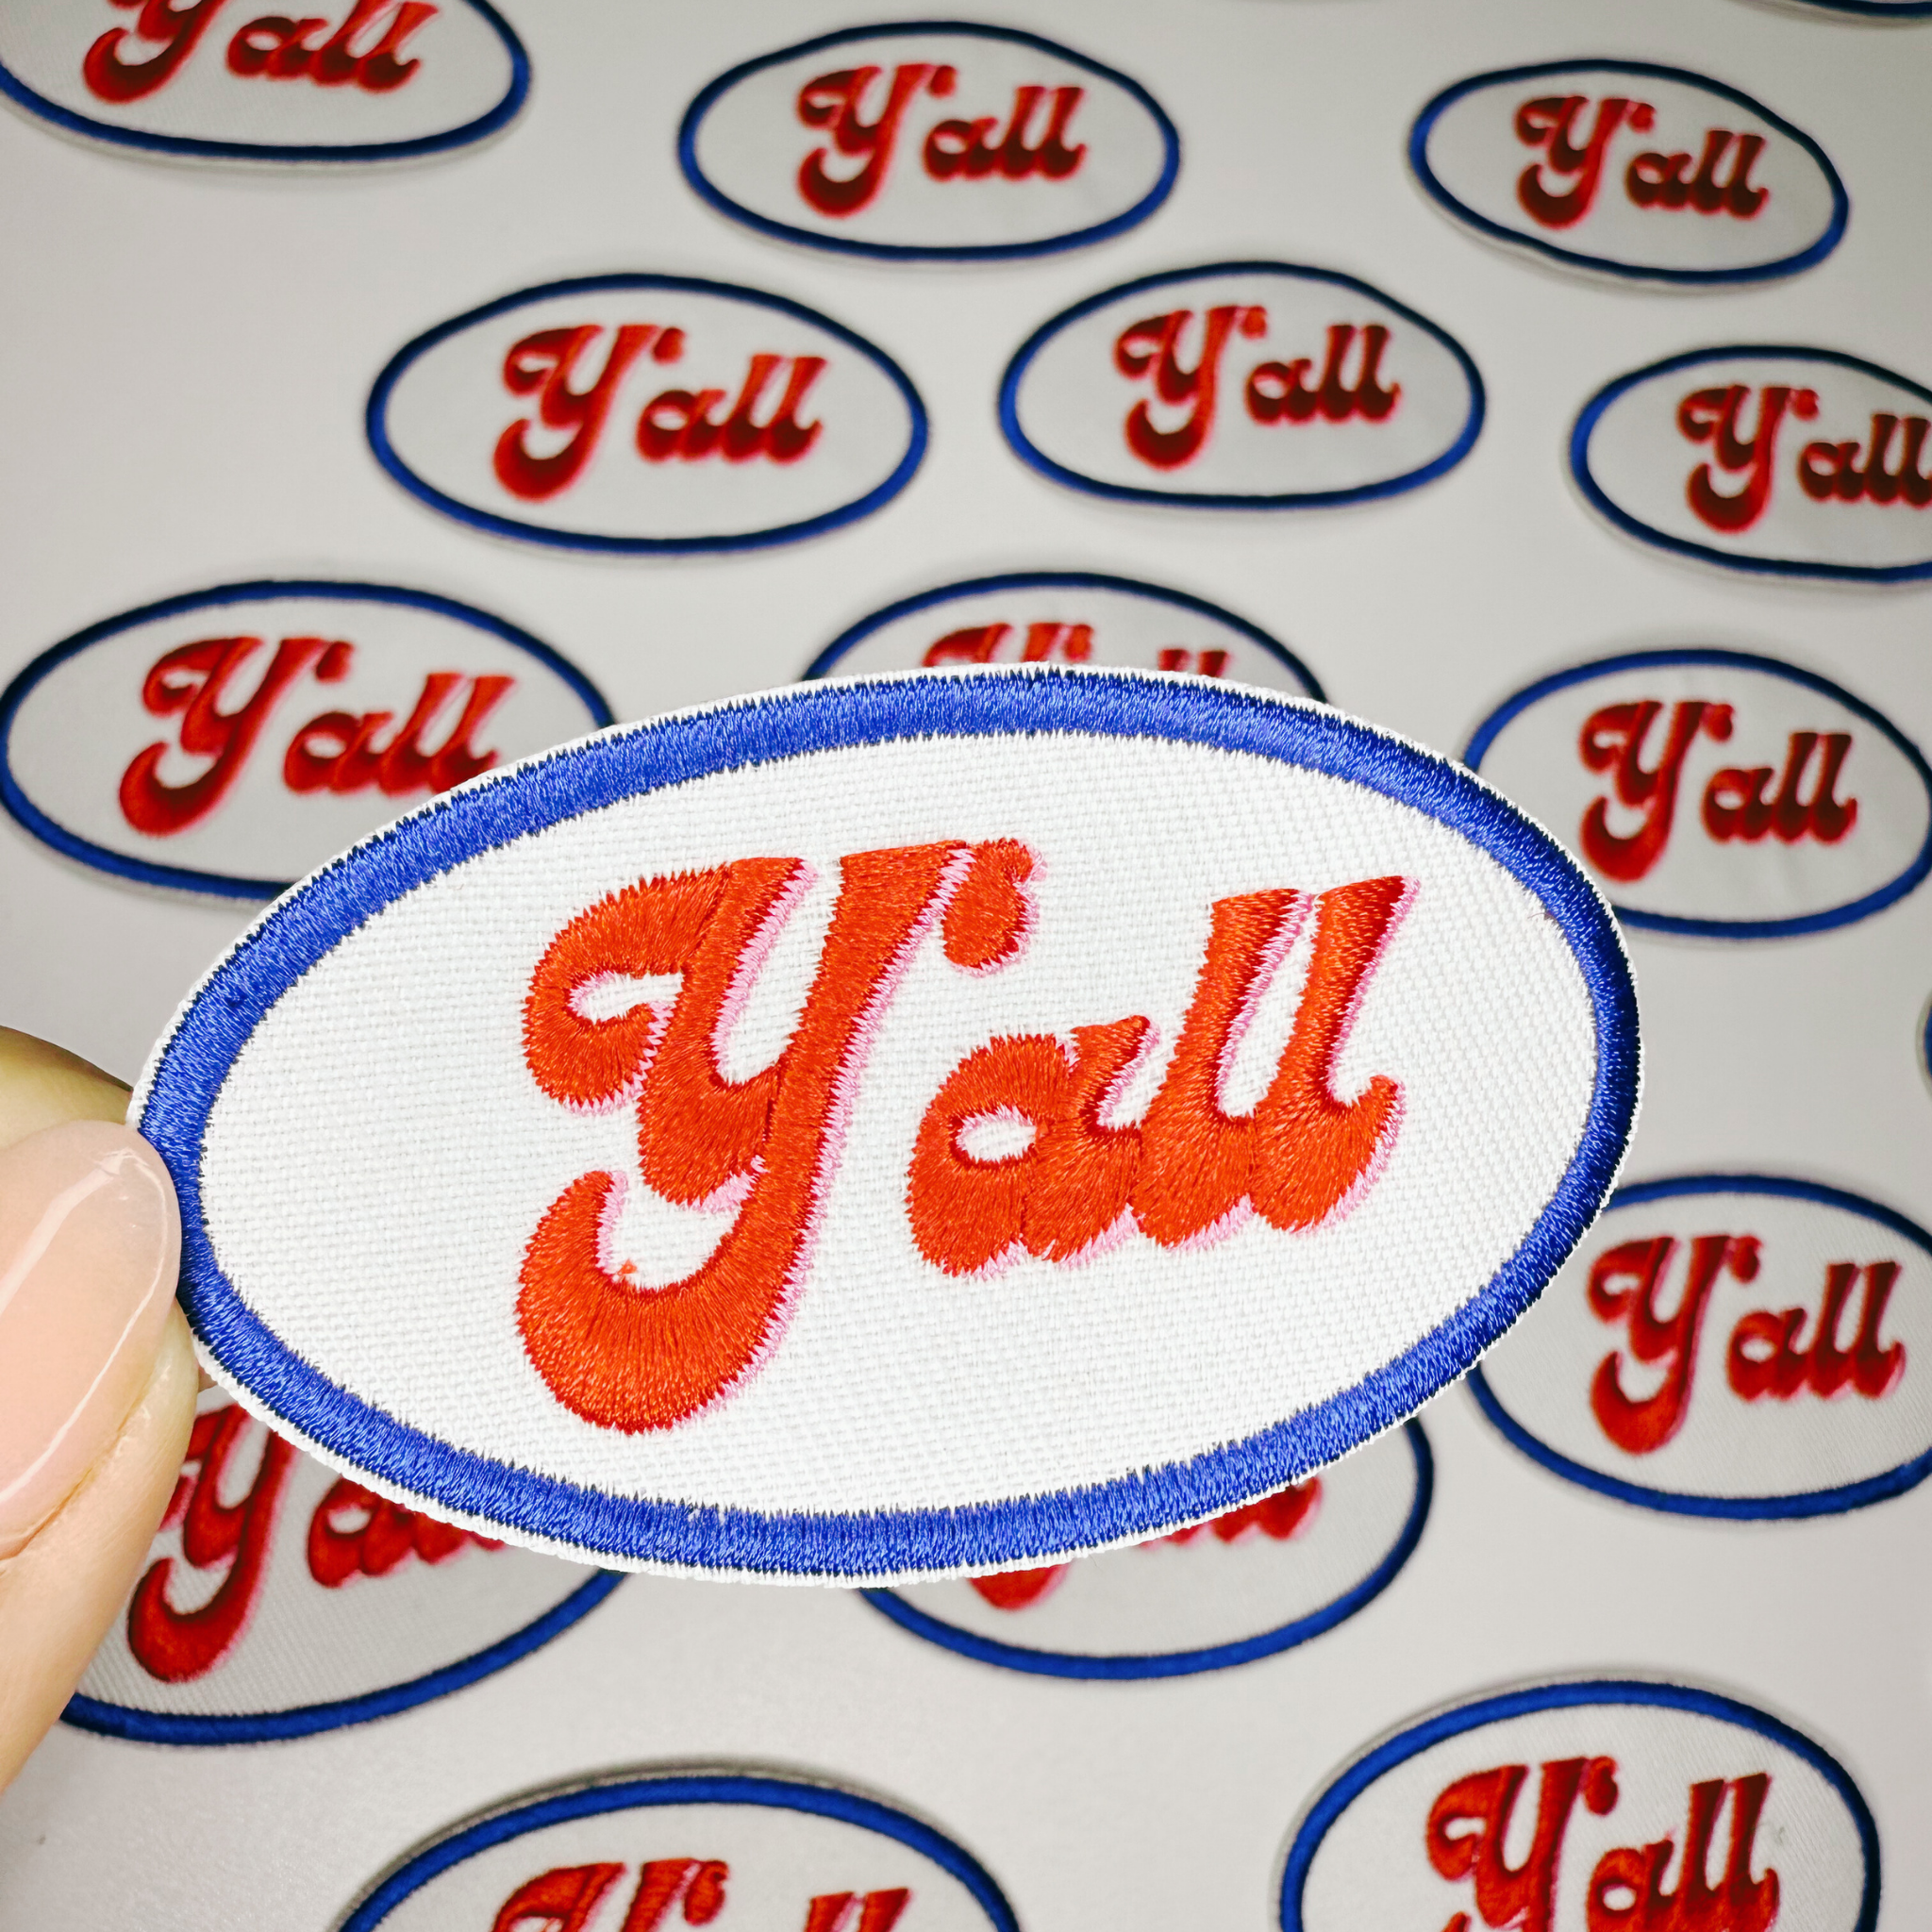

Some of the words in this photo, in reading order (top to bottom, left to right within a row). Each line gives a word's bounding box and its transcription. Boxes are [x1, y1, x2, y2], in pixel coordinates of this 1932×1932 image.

[797, 62, 1088, 218] Y'all
[1515, 95, 1769, 229] Y'all
[493, 324, 826, 503] Y'all
[1114, 305, 1401, 472] Y'all
[1677, 385, 1932, 534] Y'all
[119, 637, 514, 837] Y'all
[1579, 700, 1857, 883] Y'all
[515, 839, 1417, 1434] Y'all
[1587, 1234, 1906, 1456] Y'all
